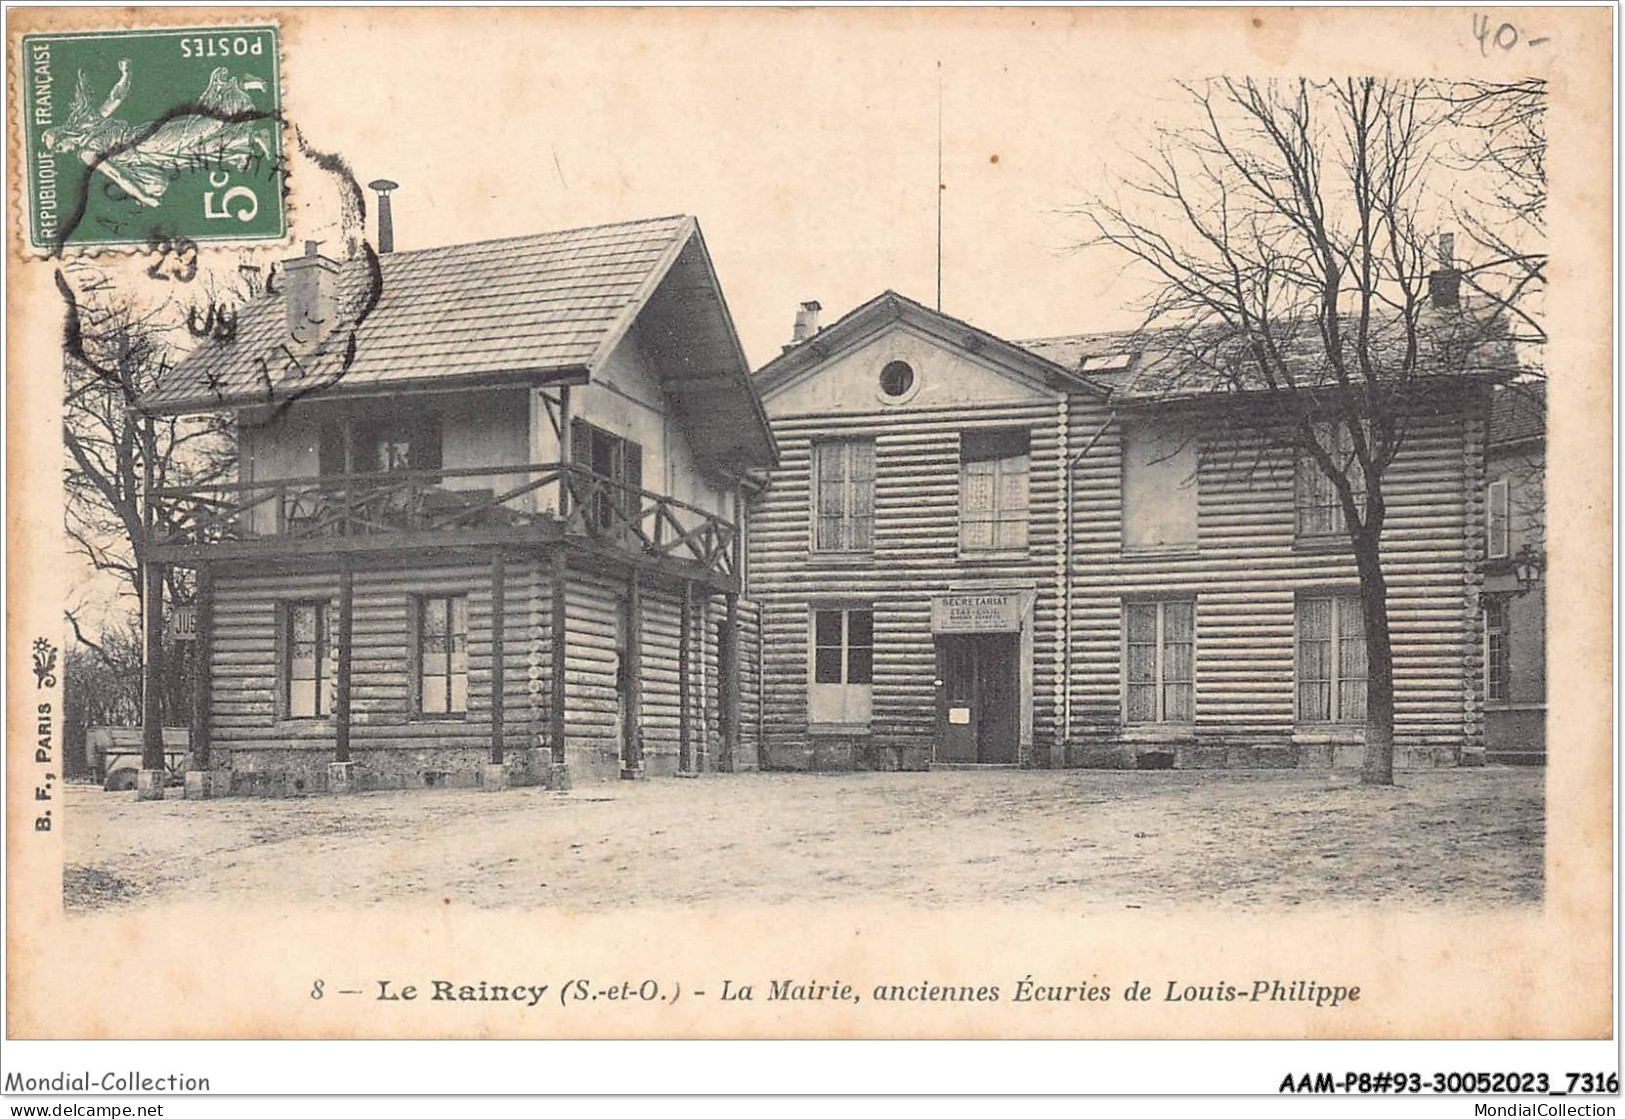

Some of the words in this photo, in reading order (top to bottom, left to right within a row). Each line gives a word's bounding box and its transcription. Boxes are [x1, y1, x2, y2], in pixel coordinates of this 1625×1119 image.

[180, 36, 263, 58] POSTES
[34, 43, 52, 126] FRANÇAISE
[942, 597, 1007, 606] SECRETARIAT
[35, 702, 53, 764] PARIS
[35, 810, 52, 832] B.
